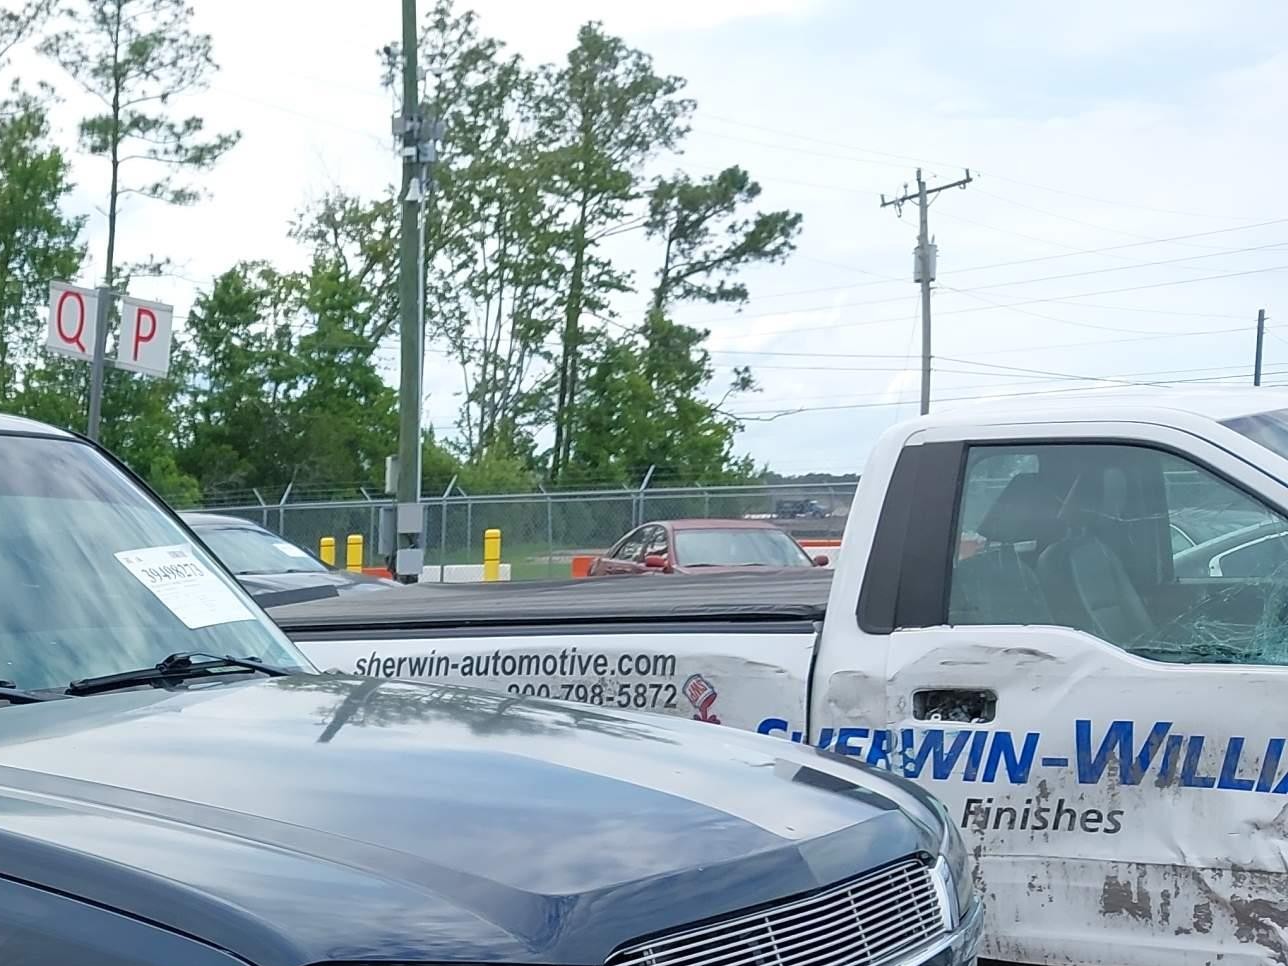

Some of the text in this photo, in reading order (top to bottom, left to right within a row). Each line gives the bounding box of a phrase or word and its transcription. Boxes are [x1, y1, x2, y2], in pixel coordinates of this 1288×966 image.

[56, 290, 86, 353] Q
[132, 307, 157, 362] P
[140, 562, 205, 584] 39498273
[353, 647, 677, 679] sherwin-automotive.com
[756, 718, 1288, 795] ERWIN-WILLI
[960, 797, 1125, 834] Finishes
